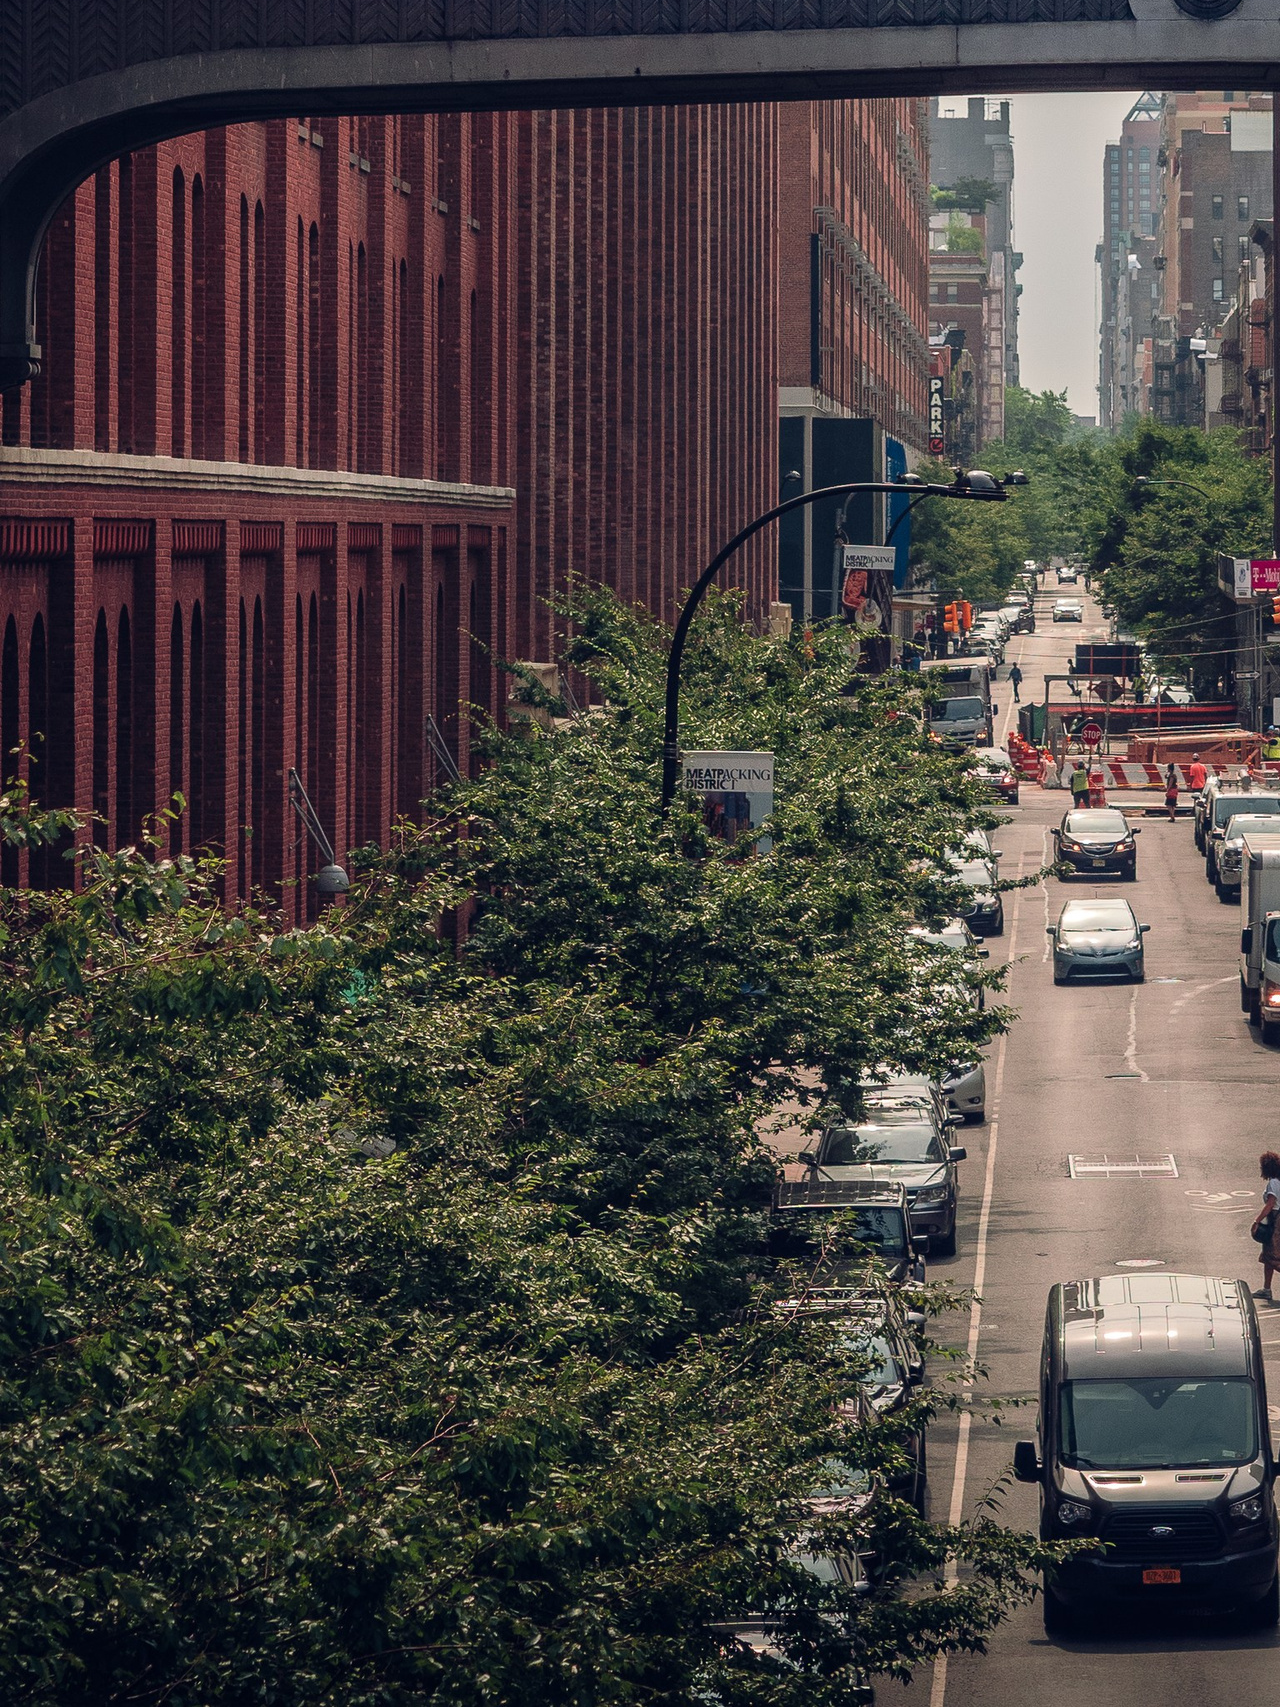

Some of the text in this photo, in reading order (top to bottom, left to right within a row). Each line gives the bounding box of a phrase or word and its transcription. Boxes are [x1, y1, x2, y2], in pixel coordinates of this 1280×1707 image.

[930, 379, 942, 433] PARK
[846, 555, 893, 563] MEATPACKING
[1083, 730, 1101, 740] STOP
[686, 768, 771, 781] MEATPACKING
[686, 779, 737, 790] DISTRICT
